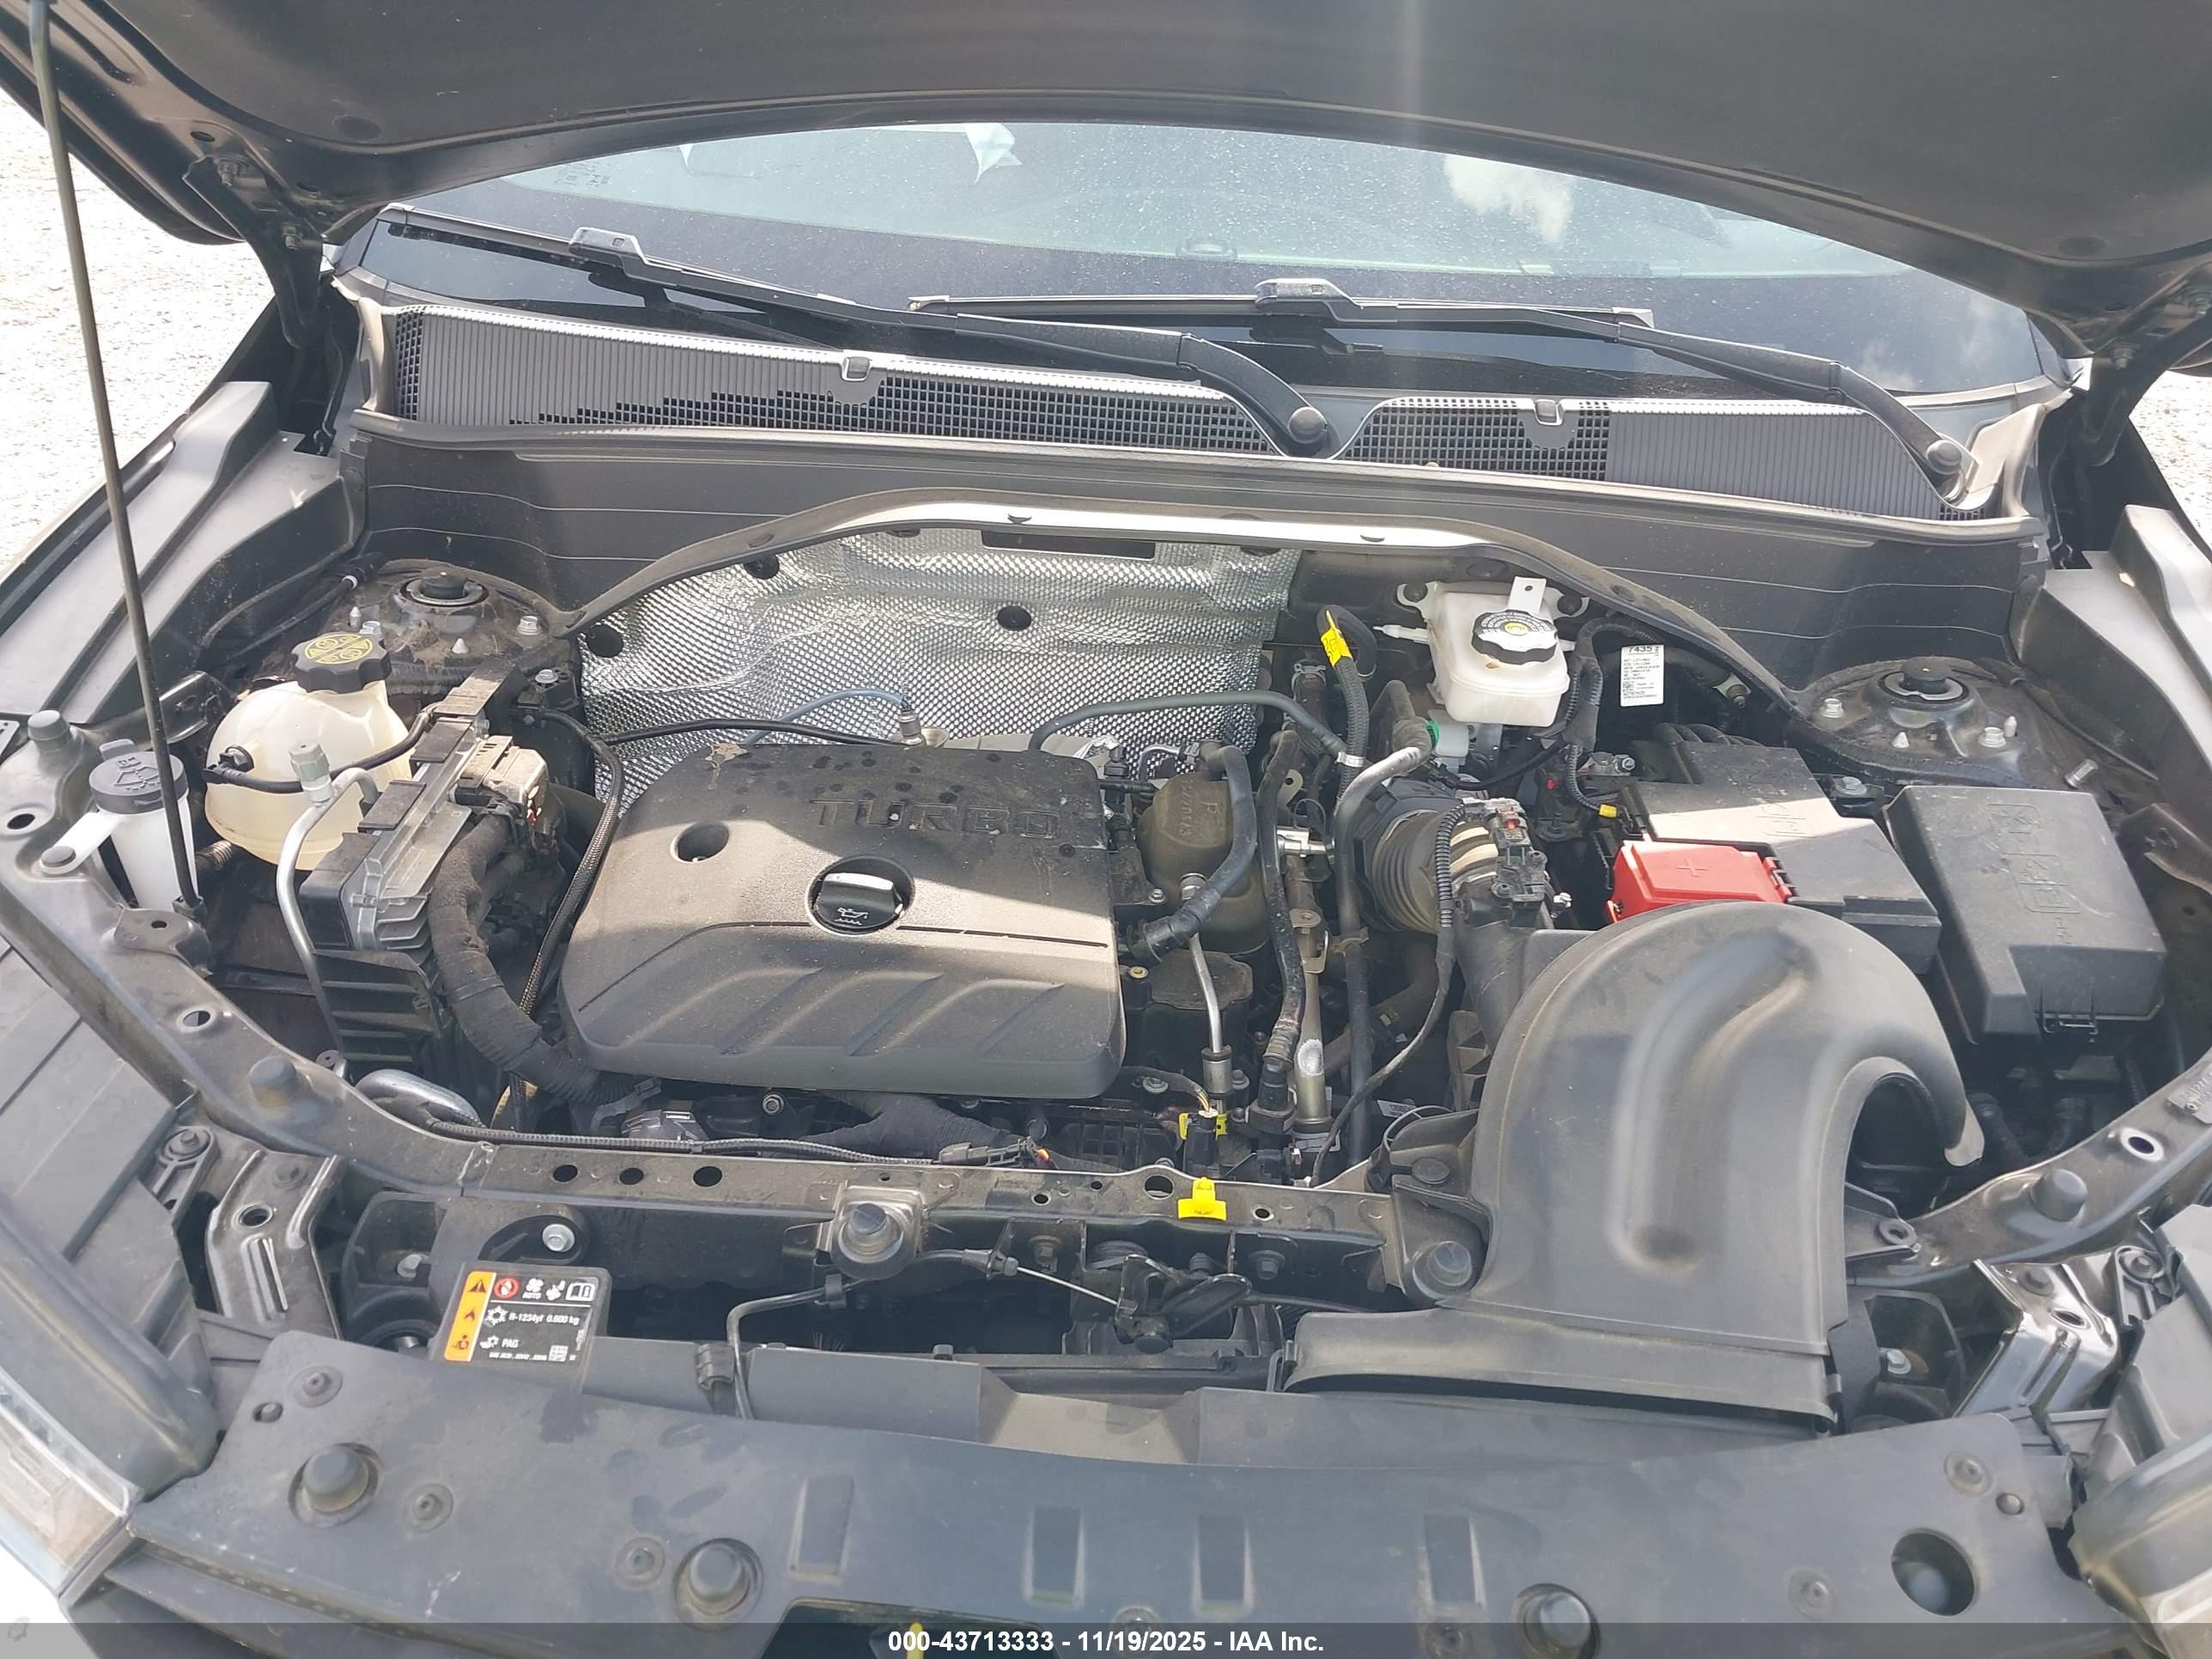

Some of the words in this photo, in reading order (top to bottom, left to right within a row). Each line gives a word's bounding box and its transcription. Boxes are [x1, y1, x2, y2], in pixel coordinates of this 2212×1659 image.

[809, 799, 1060, 839] TURBO
[569, 1316, 580, 1326] kg
[501, 1339, 519, 1348] PAG
